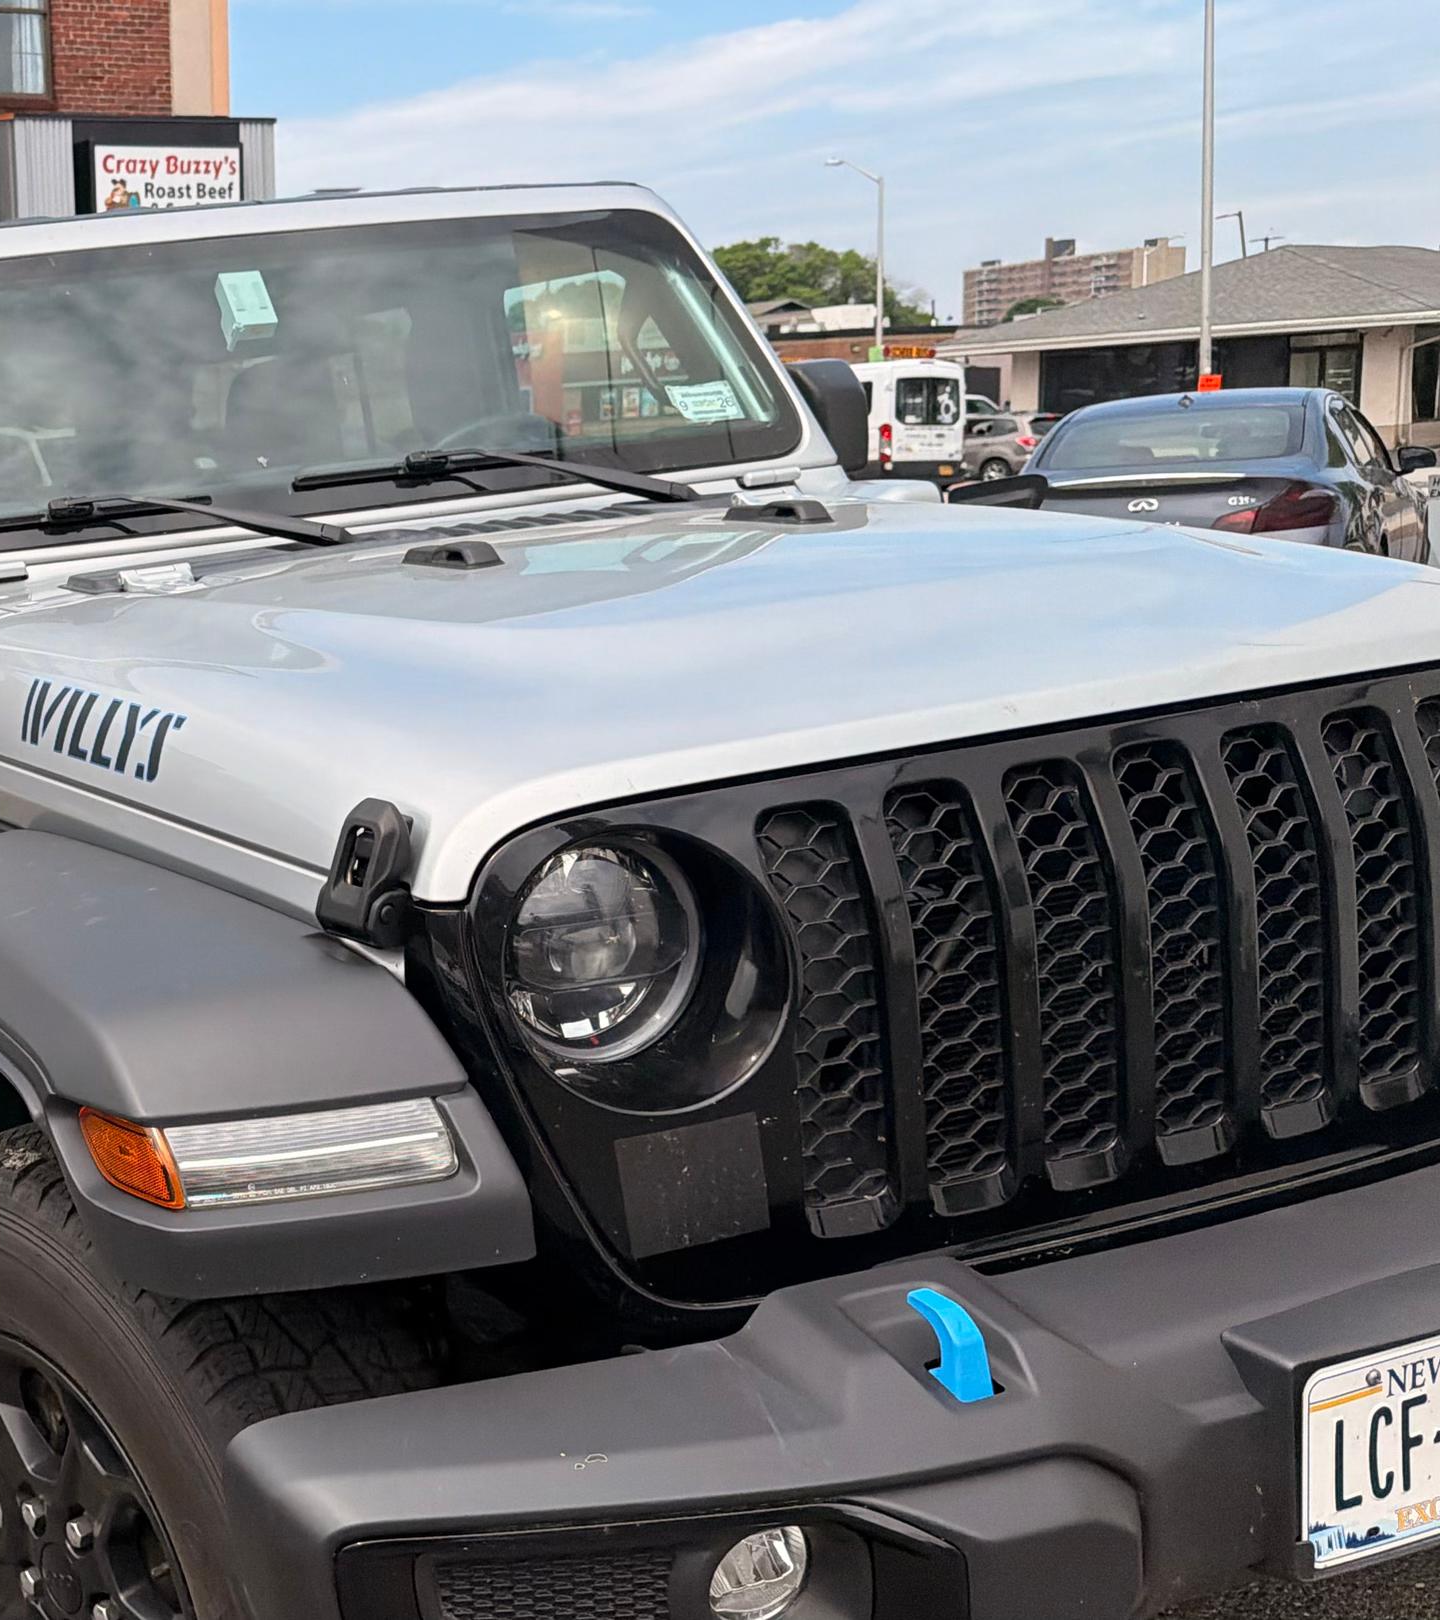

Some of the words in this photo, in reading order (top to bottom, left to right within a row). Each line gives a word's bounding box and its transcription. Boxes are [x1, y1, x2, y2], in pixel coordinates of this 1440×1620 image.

[102, 153, 160, 179] Crazy
[165, 154, 237, 180] Buzzy's
[144, 182, 192, 199] Roast
[197, 182, 234, 199] Beef
[21, 678, 187, 782] WILLYS
